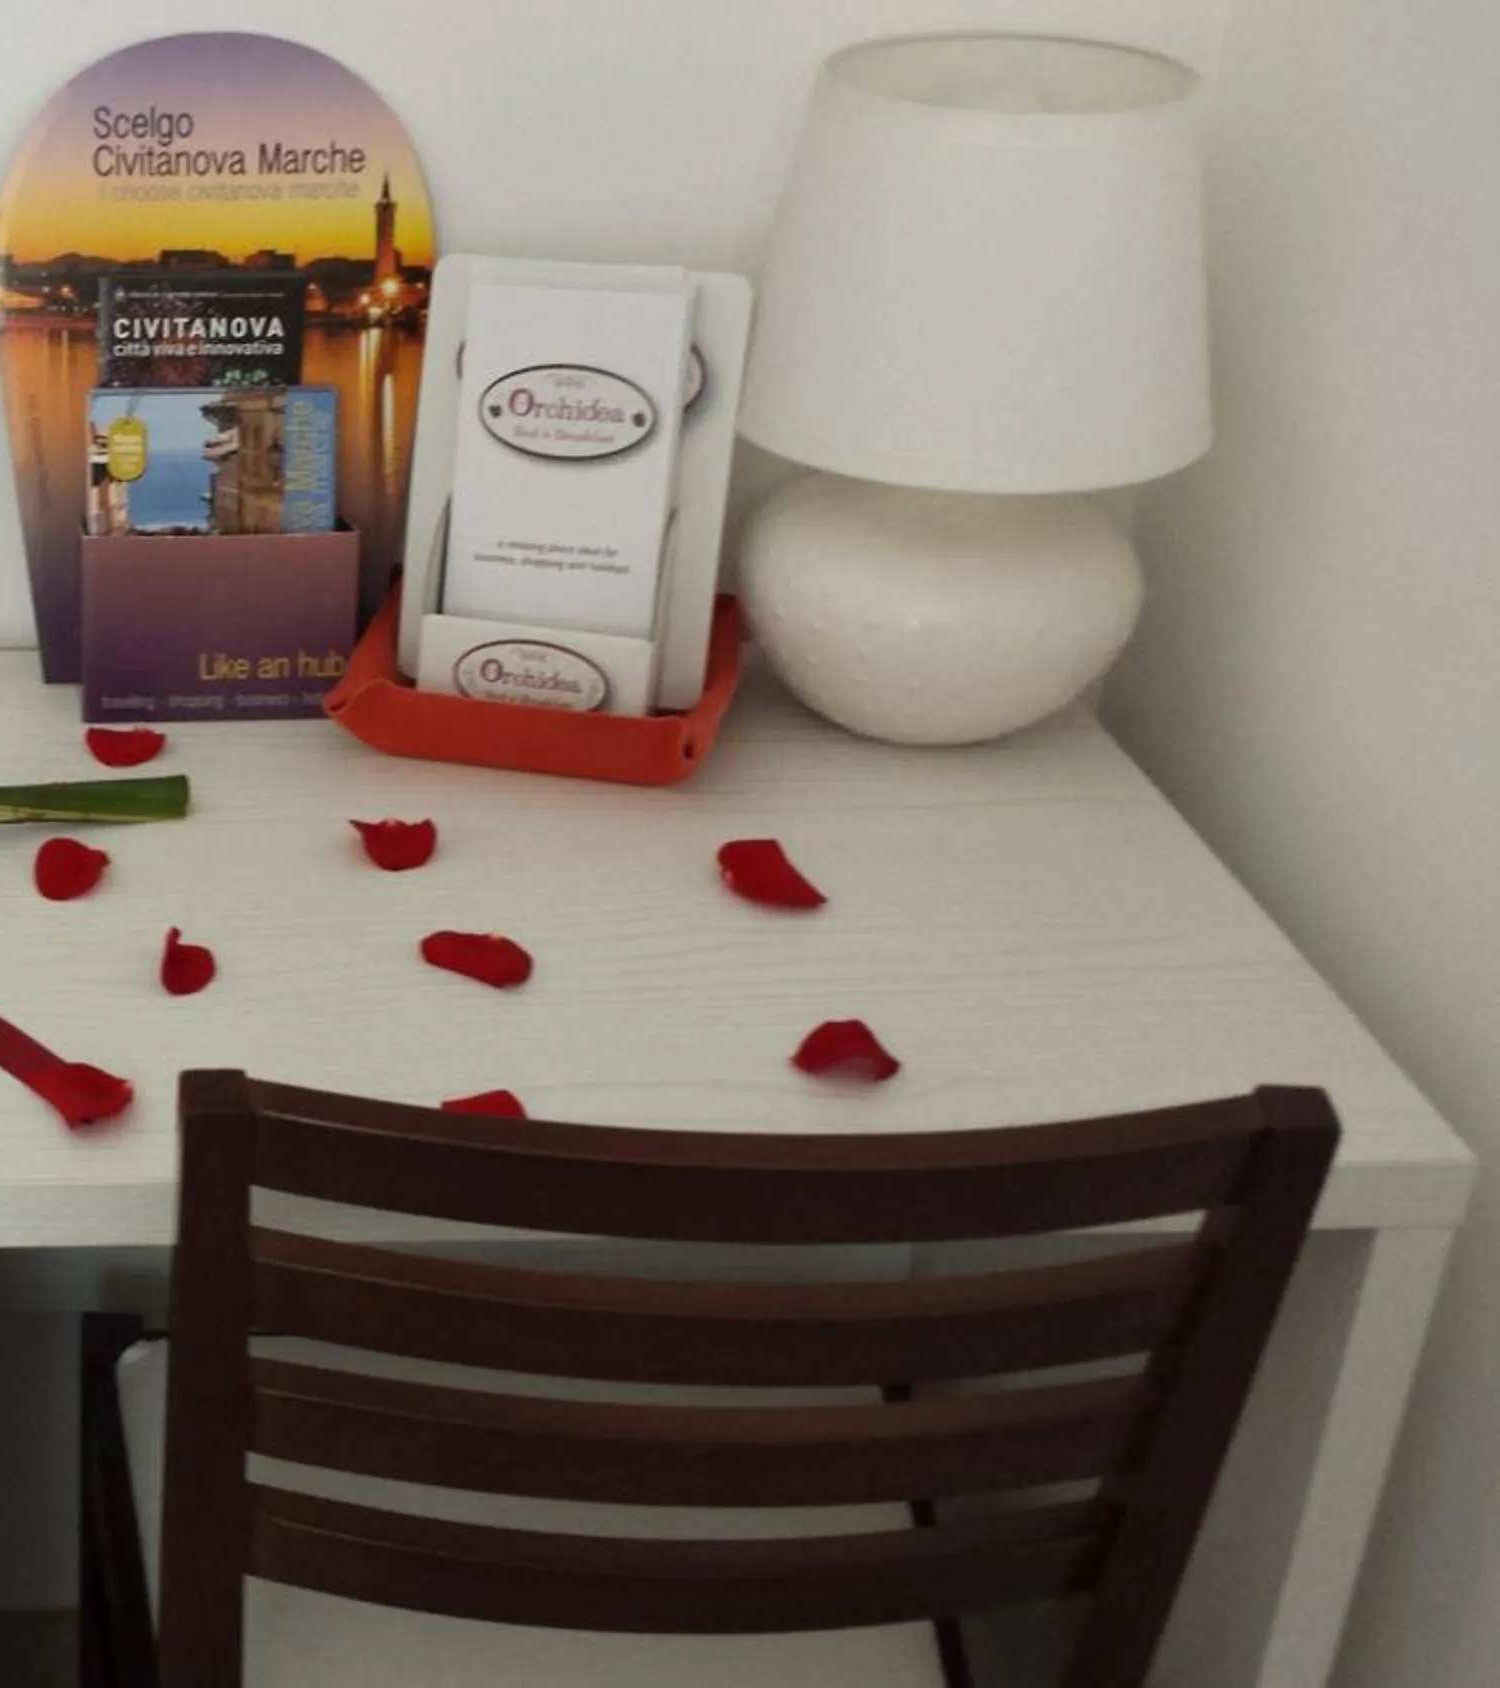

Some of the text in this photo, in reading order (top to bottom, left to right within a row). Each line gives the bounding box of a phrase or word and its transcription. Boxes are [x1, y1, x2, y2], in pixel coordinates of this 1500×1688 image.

[93, 106, 195, 146] Scelgo
[92, 141, 366, 177] Civitanova Marche
[113, 316, 286, 340] CIVITANOVA
[113, 340, 286, 358] città viva e innovativa
[508, 387, 626, 424] Orchidea
[199, 650, 346, 681] Like an hub
[480, 657, 583, 694] Orchidea
